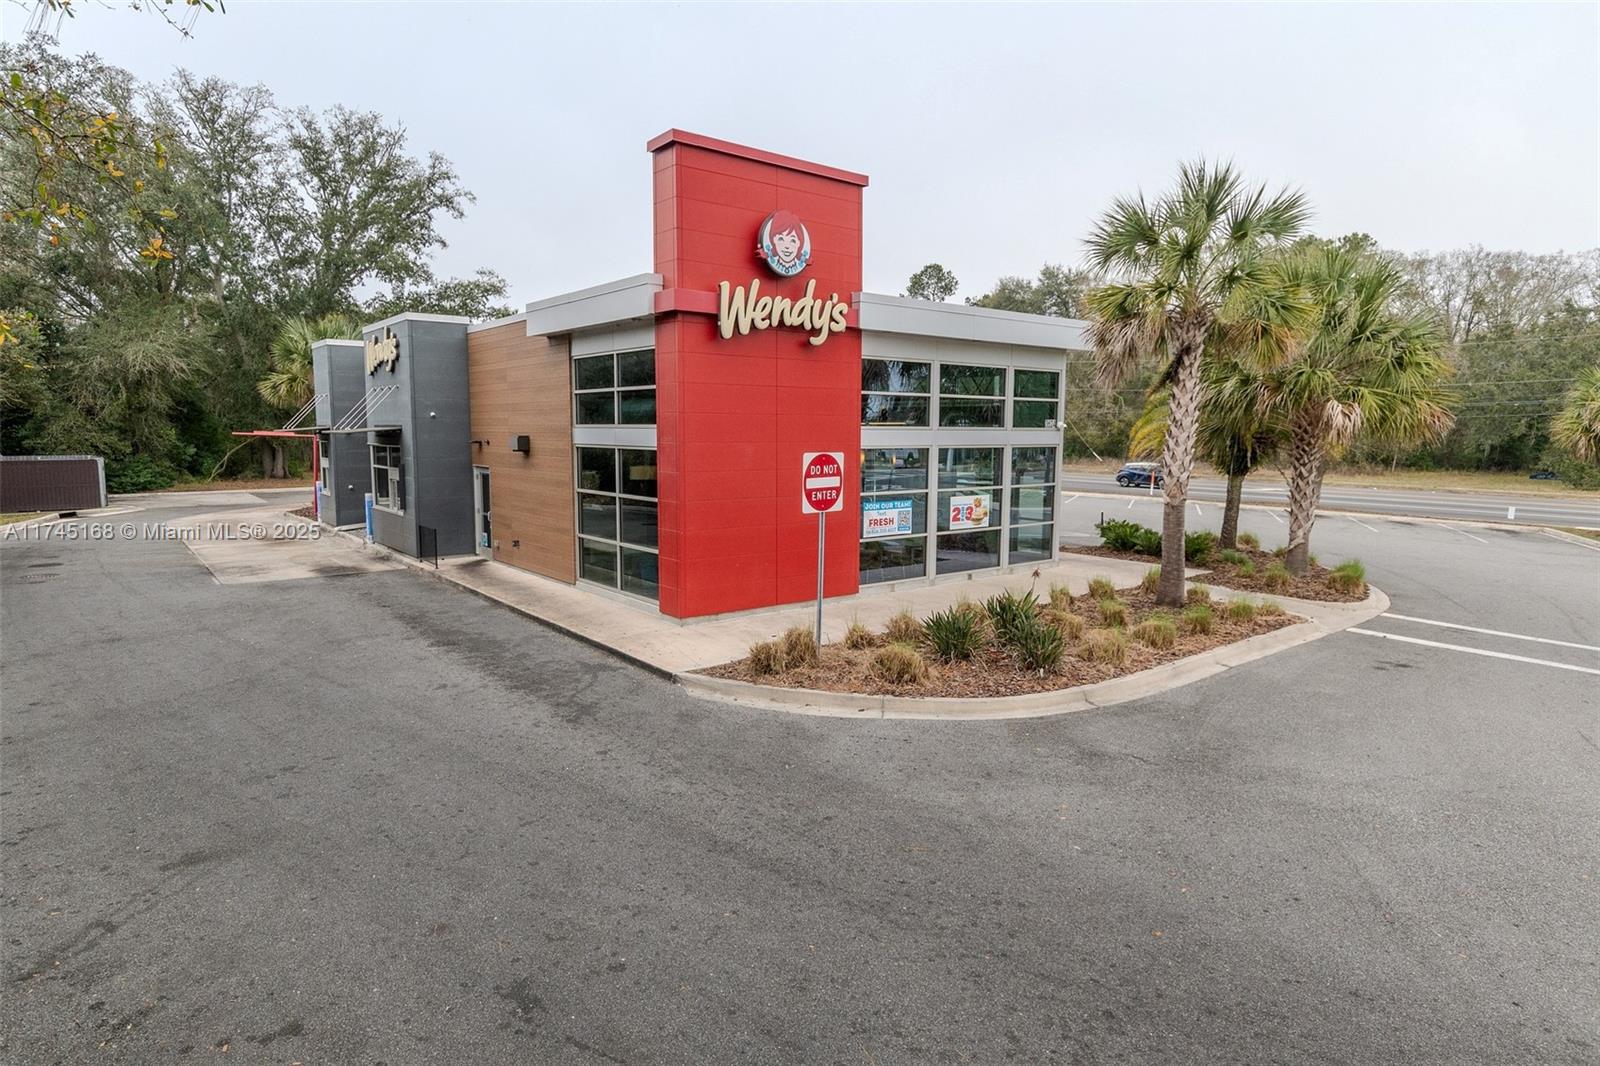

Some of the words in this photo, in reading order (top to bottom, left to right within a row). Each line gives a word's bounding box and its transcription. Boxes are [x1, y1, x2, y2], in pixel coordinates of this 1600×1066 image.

[719, 278, 849, 346] Wendy's
[810, 465, 821, 475] DO
[823, 464, 838, 475] NOT
[811, 490, 837, 501] ENTER
[864, 502, 880, 510] JOIN
[952, 507, 961, 522] 2
[868, 517, 895, 527] FRESH
